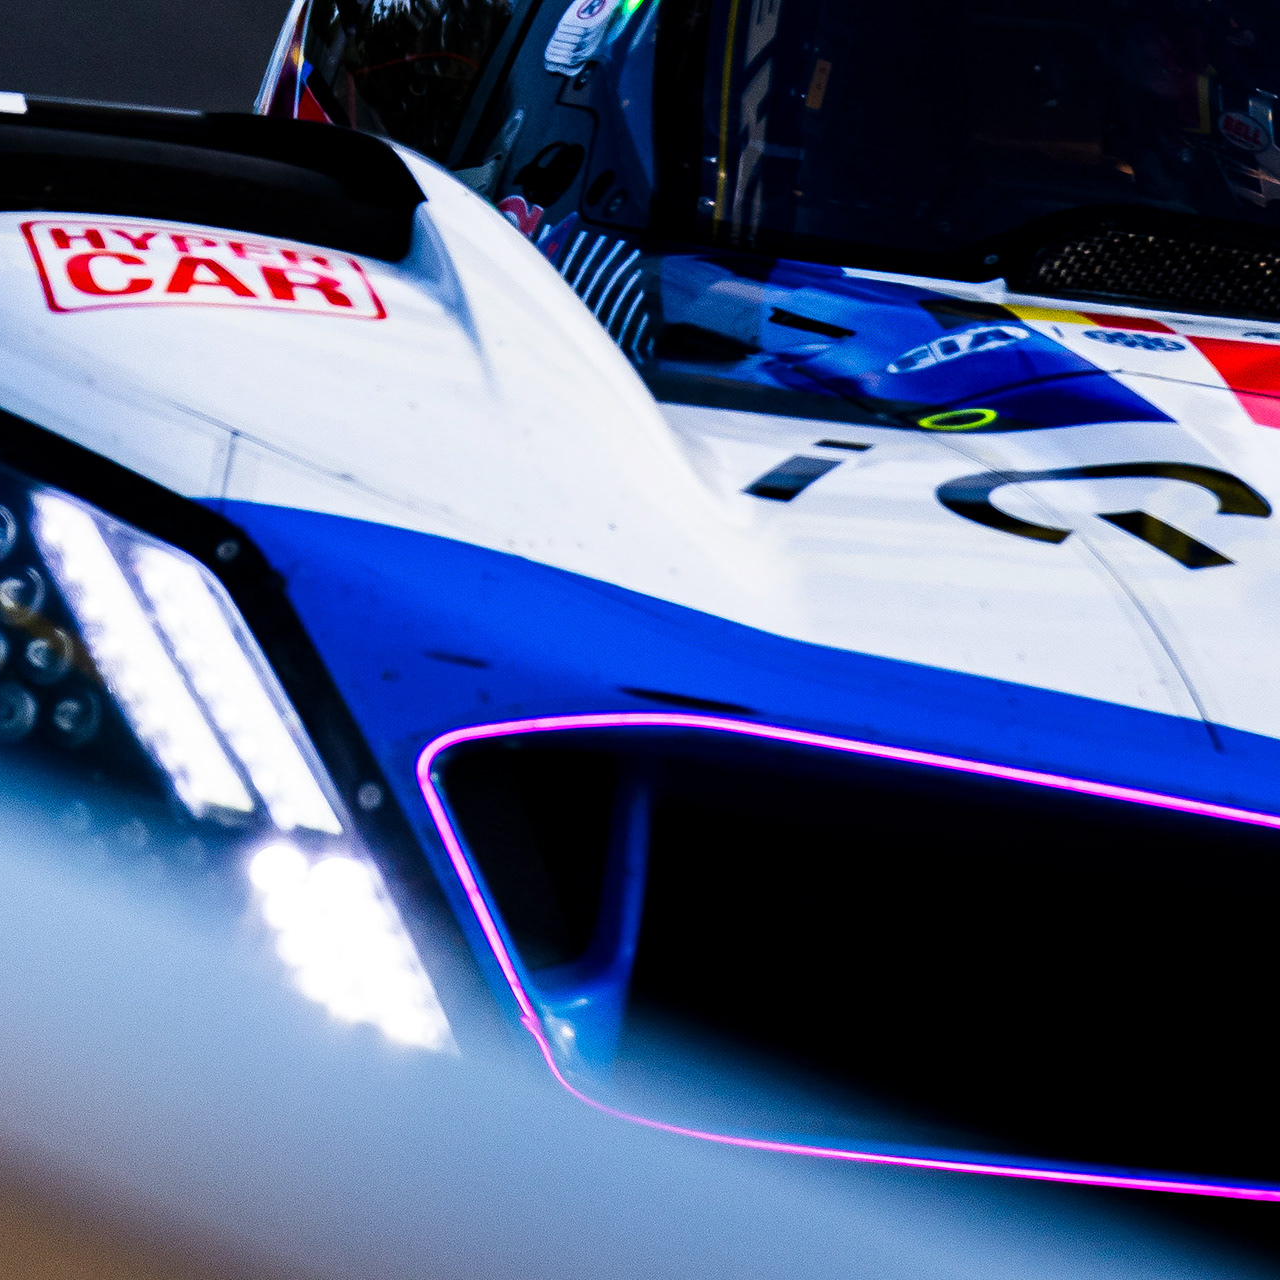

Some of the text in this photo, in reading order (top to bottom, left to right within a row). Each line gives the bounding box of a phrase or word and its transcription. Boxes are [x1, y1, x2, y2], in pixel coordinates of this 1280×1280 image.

[49, 227, 334, 269] HYPER
[65, 252, 354, 308] CAR
[887, 326, 1029, 372] FIA
